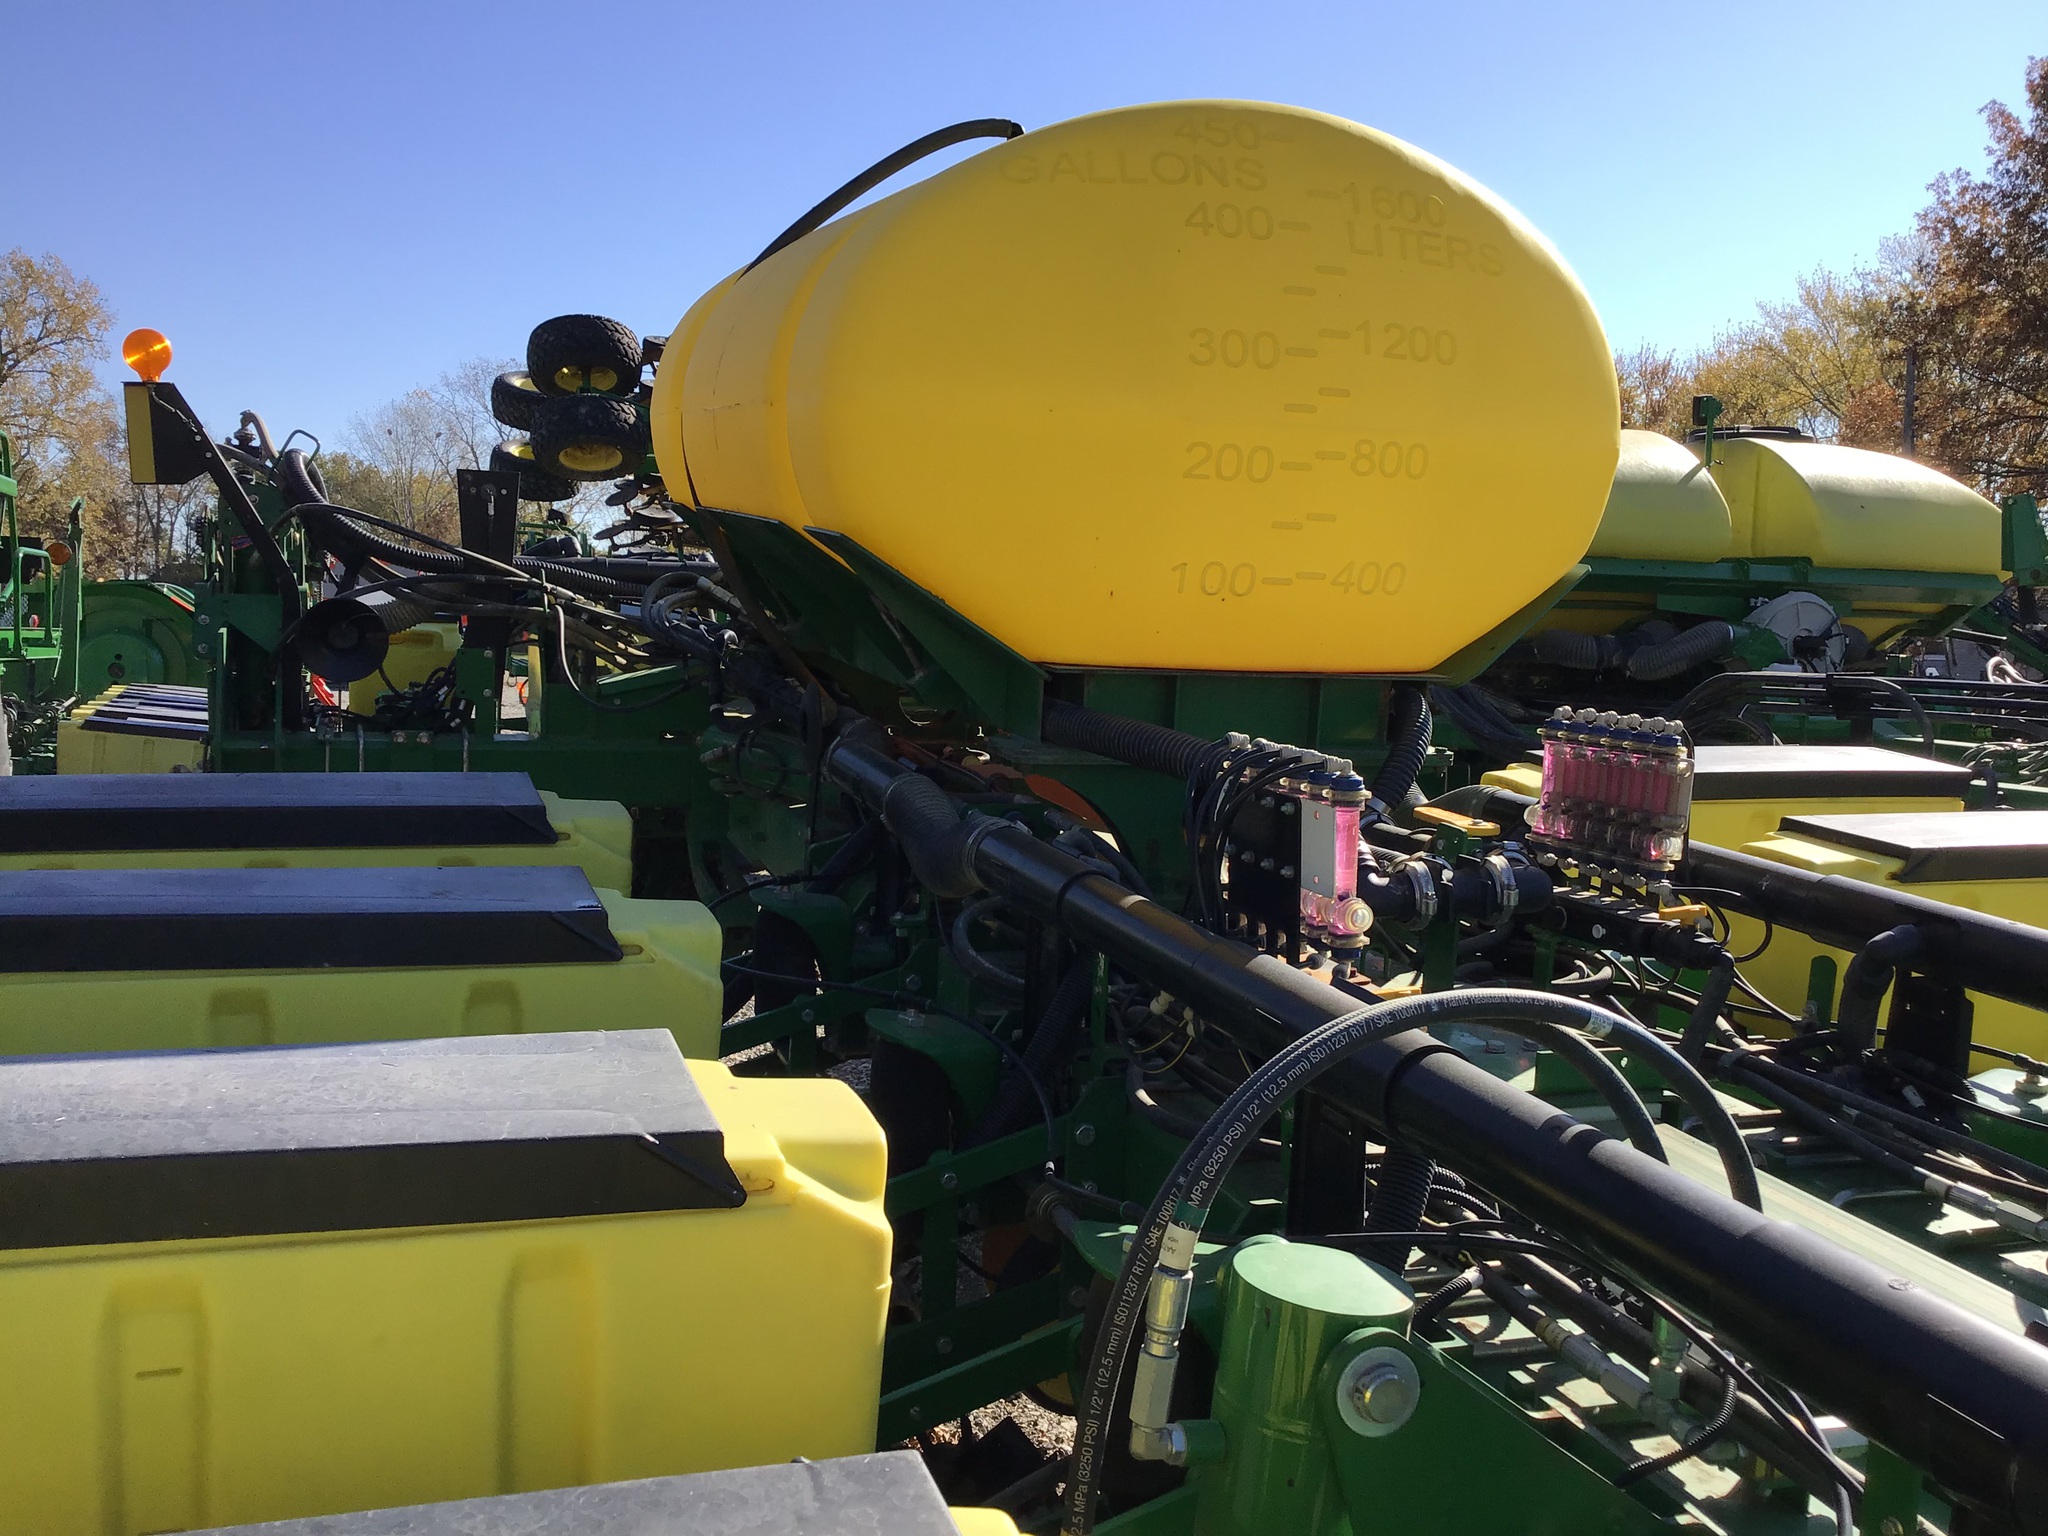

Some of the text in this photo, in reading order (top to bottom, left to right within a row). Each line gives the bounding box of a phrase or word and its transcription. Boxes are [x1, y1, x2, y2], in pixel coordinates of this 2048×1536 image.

[1175, 114, 1261, 151] 450
[1001, 150, 1268, 192] GALLONS
[1184, 201, 1274, 241] 400
[1343, 181, 1447, 229] 1600
[1347, 218, 1506, 277] LITERS
[1188, 327, 1281, 370] 300
[1355, 318, 1458, 366] 1200
[1182, 441, 1275, 483] 200
[1350, 438, 1429, 480] 800
[1170, 561, 1257, 597] 100
[1330, 560, 1407, 596] 400
[1188, 1181, 1210, 1209] MPa
[1202, 1145, 1229, 1179] (3250
[1223, 1121, 1248, 1147] PSI)
[1260, 1076, 1287, 1104] (12.5
[1286, 1057, 1311, 1082] mm)
[1374, 1014, 1394, 1028] SAE
[1156, 1188, 1181, 1226] 100R17
[1144, 1226, 1162, 1248] SAE
[1131, 1252, 1149, 1276] R17
[1110, 1327, 1124, 1357] mm)
[1099, 1356, 1114, 1388] (12.5
[1083, 1420, 1100, 1449] PSI)
[1077, 1449, 1093, 1482] (3250
[1073, 1484, 1089, 1513] MPa
